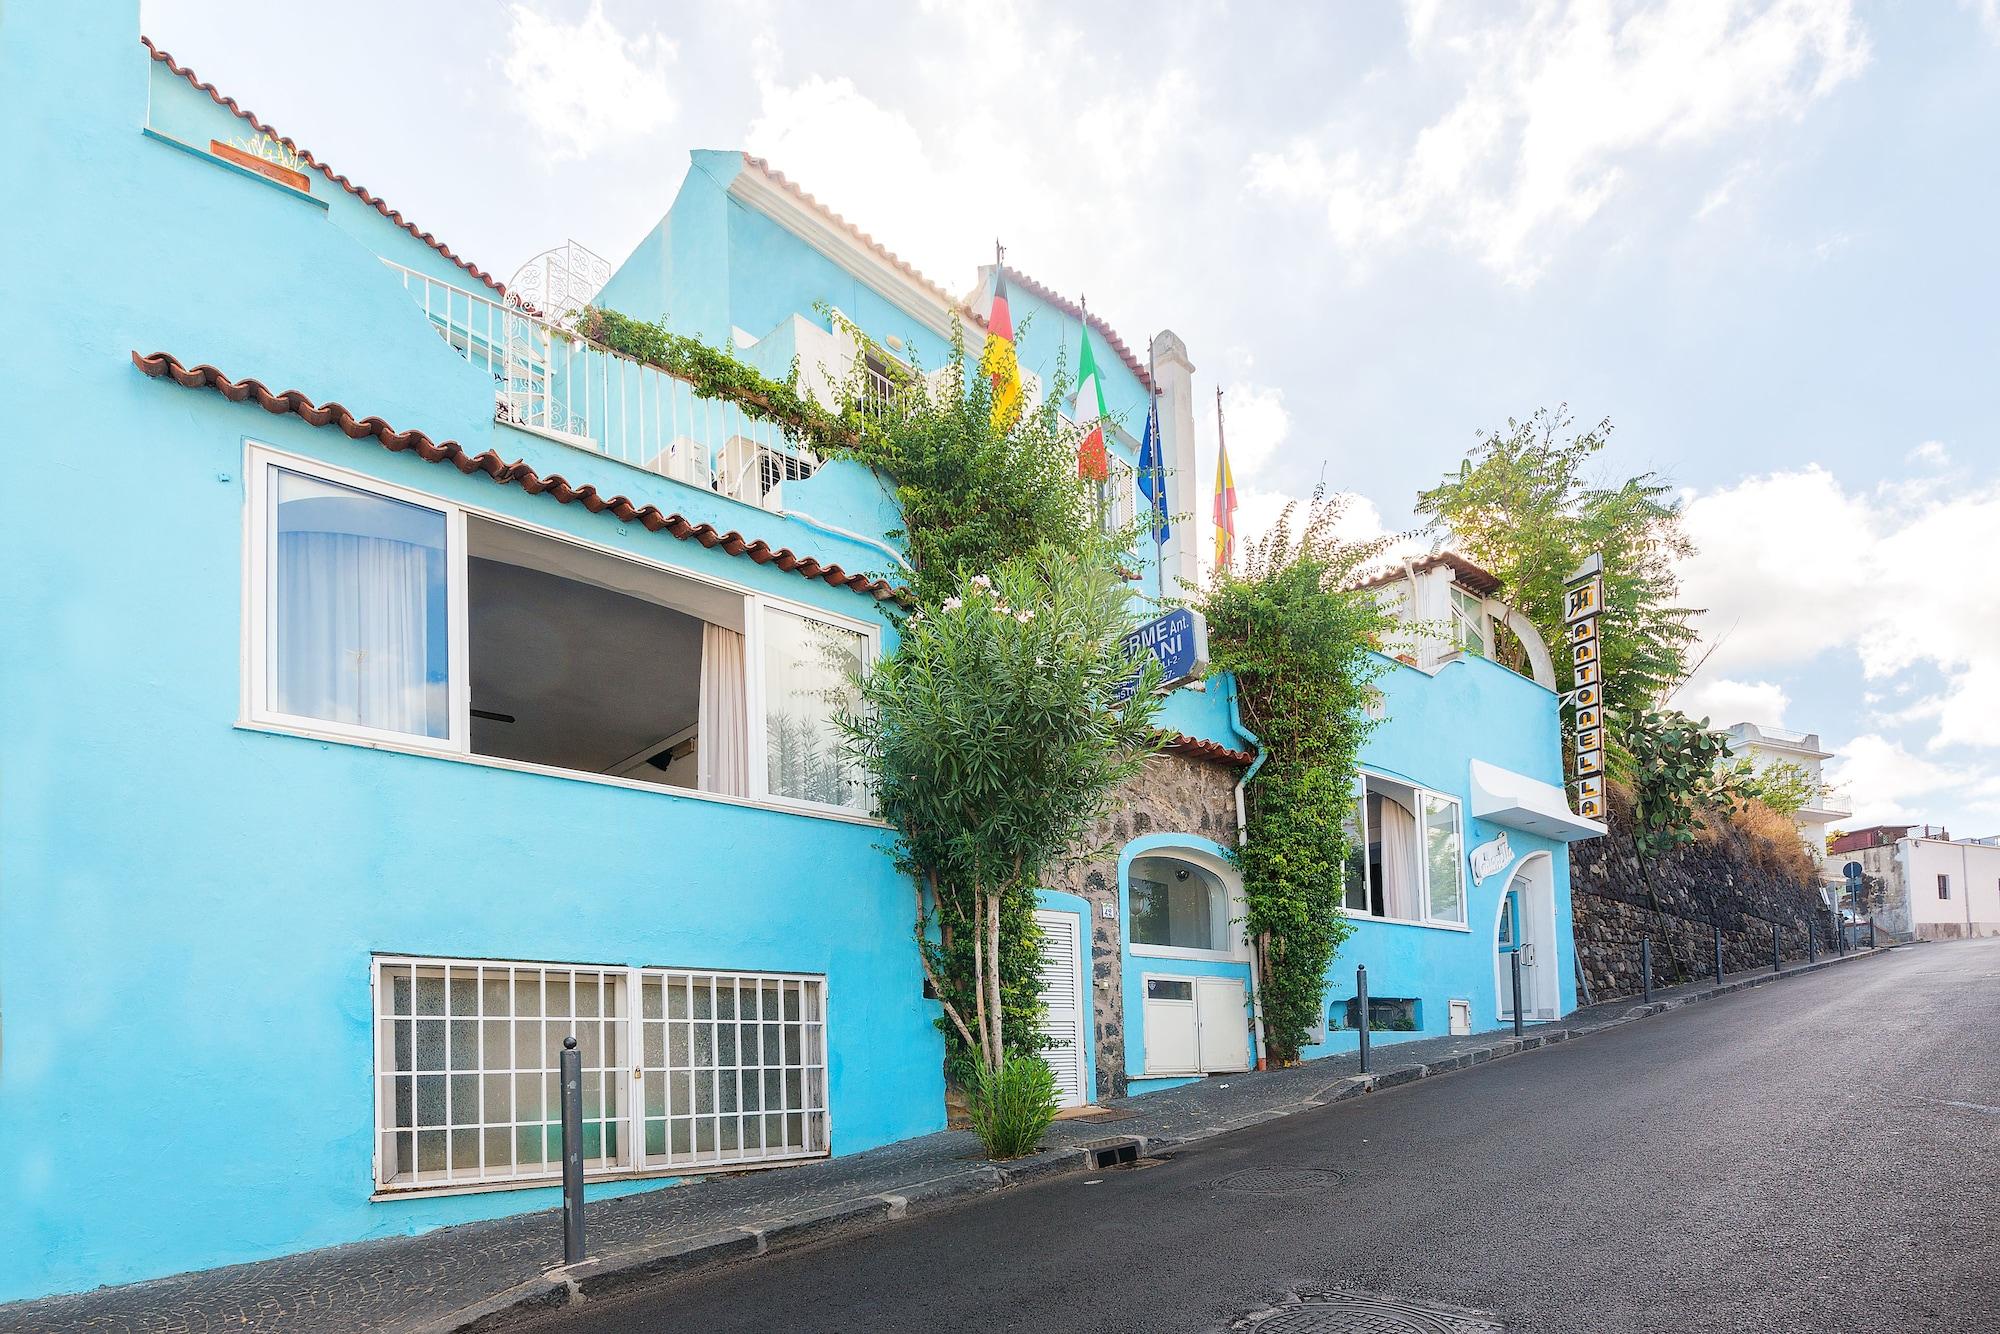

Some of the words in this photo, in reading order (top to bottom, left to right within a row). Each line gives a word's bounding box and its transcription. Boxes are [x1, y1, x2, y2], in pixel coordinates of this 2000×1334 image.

[1119, 620, 1168, 660] ERME
[1170, 615, 1189, 636] Ant.
[1145, 634, 1182, 661] ANI
